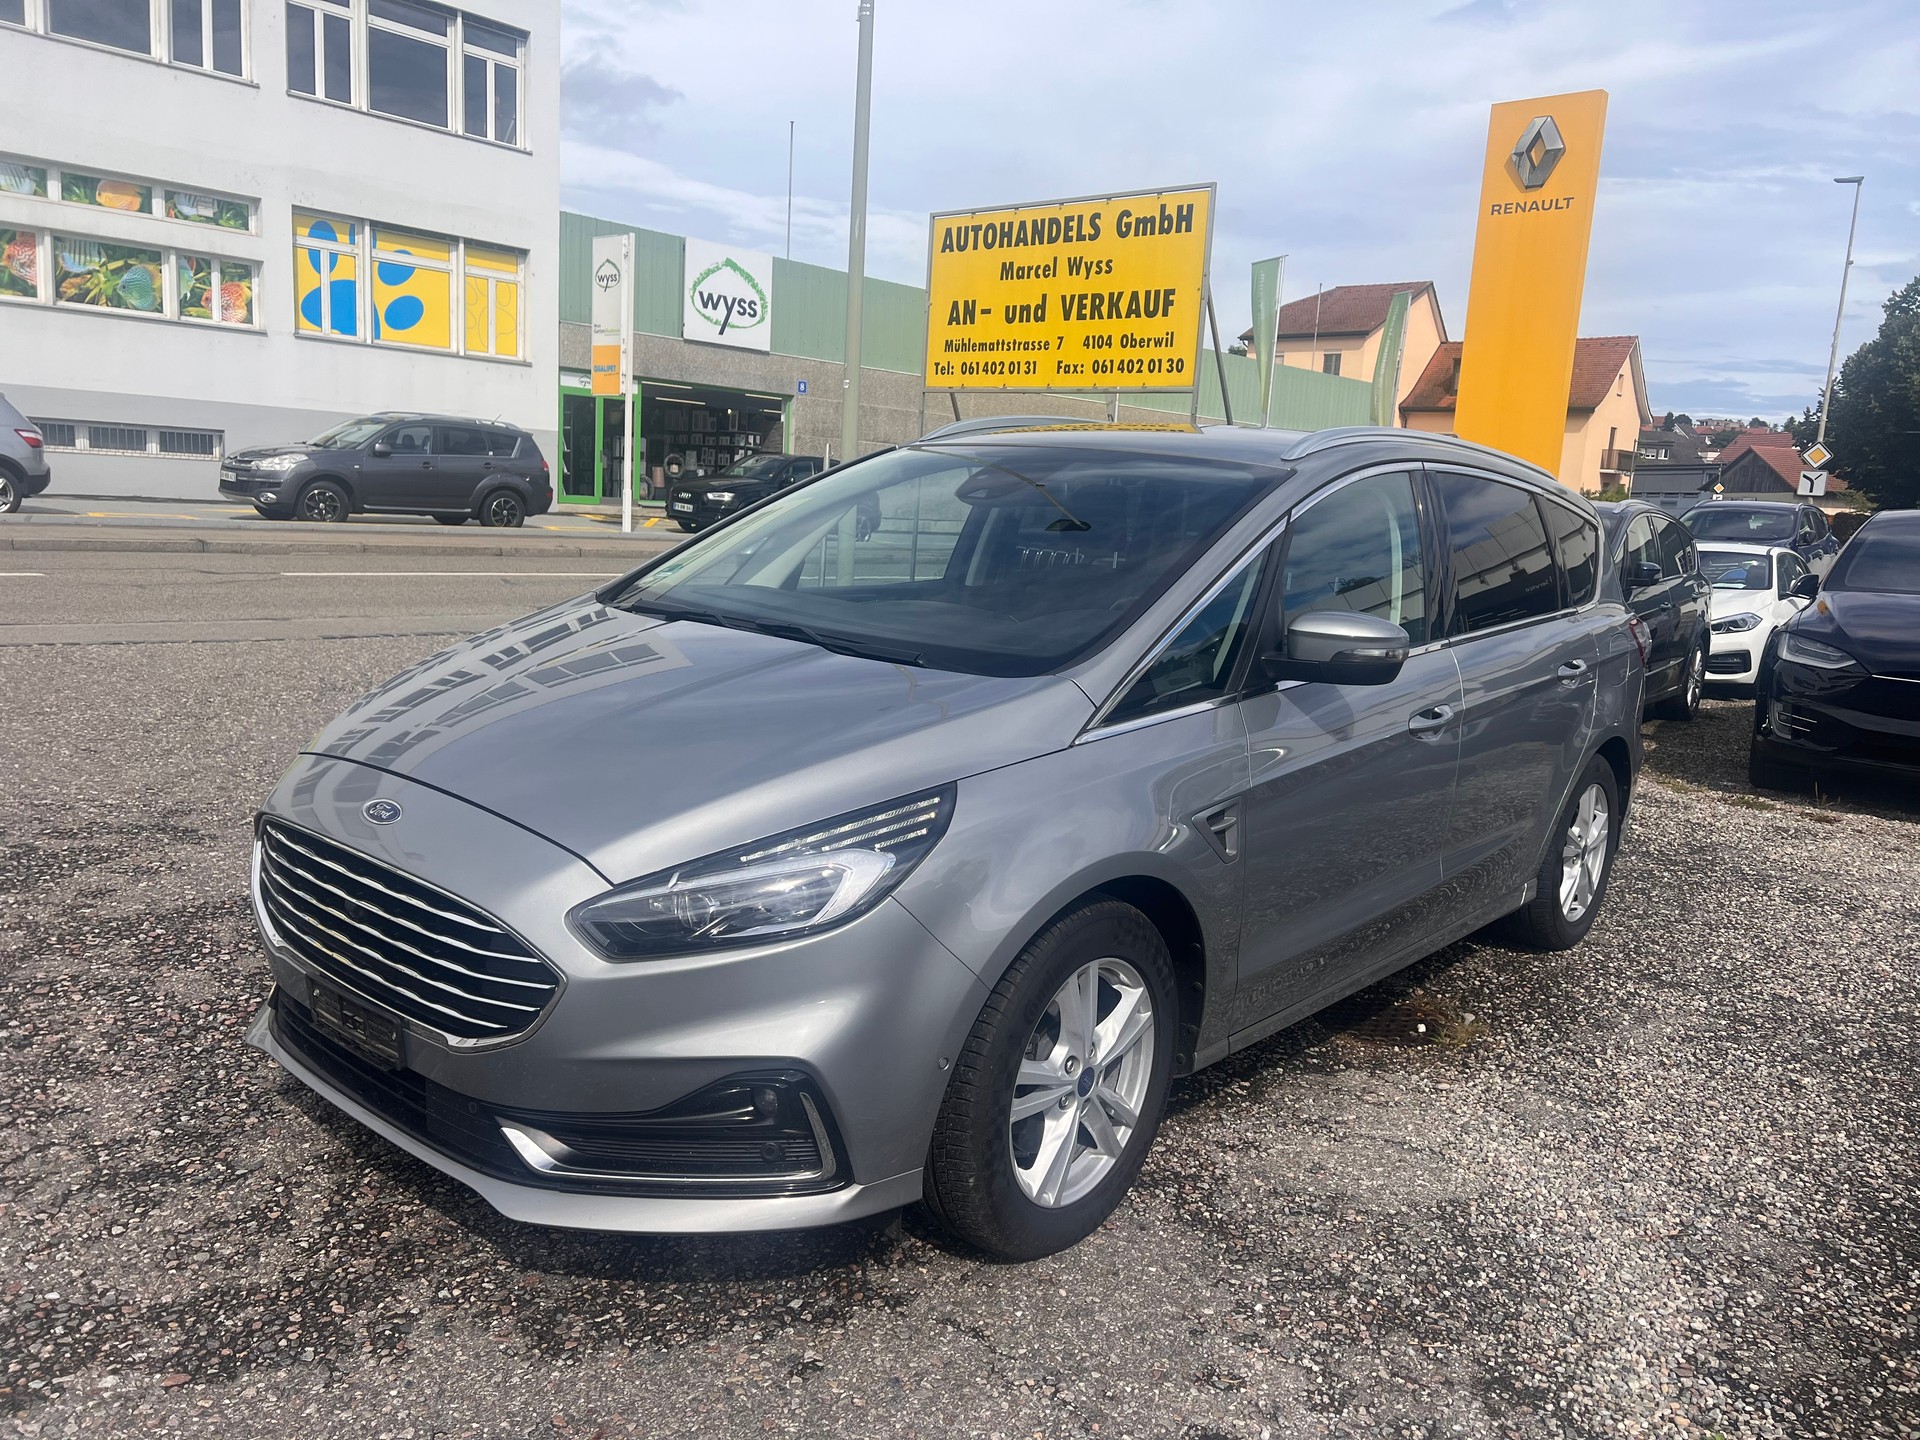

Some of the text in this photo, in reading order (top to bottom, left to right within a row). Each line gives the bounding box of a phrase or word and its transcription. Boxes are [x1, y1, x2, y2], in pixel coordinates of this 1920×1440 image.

[1490, 197, 1574, 215] RENAULT
[940, 203, 1194, 254] AUTOHANDELS GmbH
[1000, 256, 1114, 281] Marcel Wyss
[597, 273, 618, 292] wyss
[698, 290, 758, 336] wyss
[947, 288, 1176, 326] AN- und VERKAUF
[944, 331, 1175, 353] Mühlemattstrasse 7 4104 Oberwil
[934, 361, 955, 376] Tel:
[1056, 359, 1085, 375] Fax:
